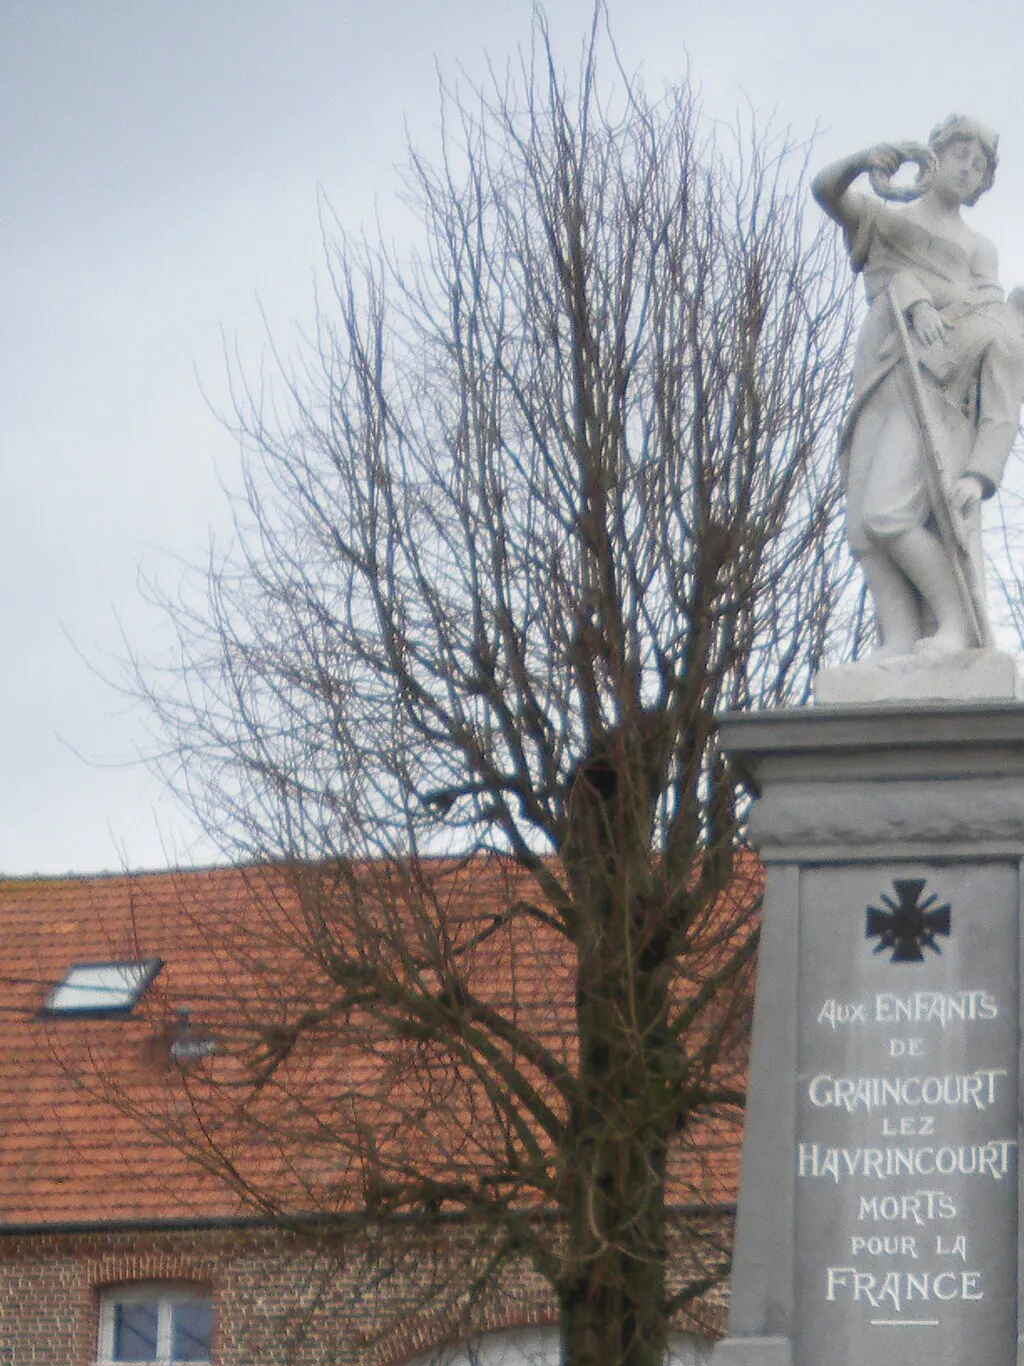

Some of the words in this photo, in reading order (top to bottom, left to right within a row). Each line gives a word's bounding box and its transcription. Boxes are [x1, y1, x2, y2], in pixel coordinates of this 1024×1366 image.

[876, 990, 998, 1027] ENFANTS
[890, 1037, 924, 1057] DE
[809, 1069, 1008, 1113] GRAINCOURT
[883, 1116, 935, 1136] LEZ
[799, 1140, 1018, 1185] HAVRINCOURT
[858, 1191, 957, 1226] MORTS
[852, 1236, 918, 1259] POUR
[936, 1236, 967, 1262] LA
[826, 1267, 984, 1312] FRANCE
